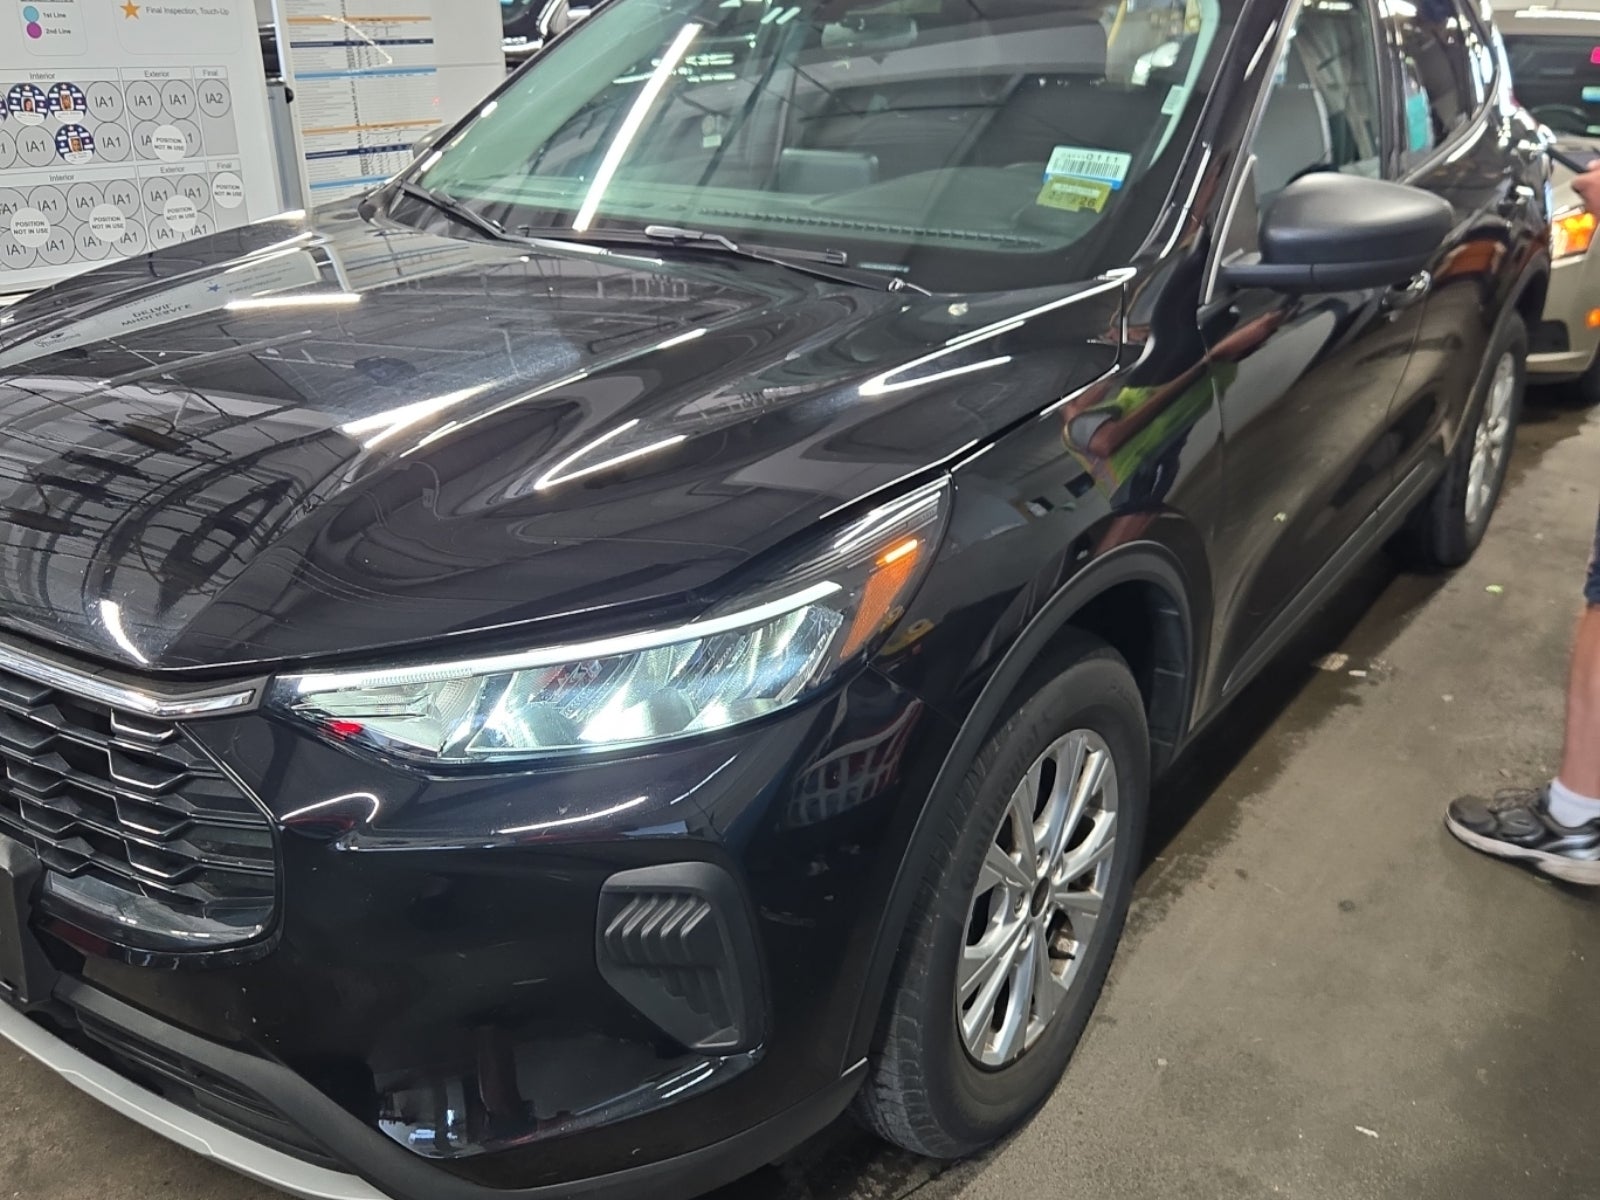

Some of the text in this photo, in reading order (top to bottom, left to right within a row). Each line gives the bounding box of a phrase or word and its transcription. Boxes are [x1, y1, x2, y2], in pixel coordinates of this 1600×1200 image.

[54, 11, 66, 19] Line
[163, 7, 199, 16] Inspection,
[200, 8, 230, 16] Touch-Up
[94, 95, 114, 108] IA1
[134, 95, 153, 107] IA1
[169, 94, 187, 105] IA1
[205, 93, 223, 104] IA2
[102, 136, 121, 149] IA1
[141, 134, 152, 146] IA
[25, 140, 46, 153] IA1
[112, 192, 131, 205] IA1
[151, 190, 168, 202] IA1
[184, 187, 201, 199] IA1
[37, 200, 57, 212] IA1
[75, 196, 95, 208] IA1
[157, 228, 174, 240] IA1
[191, 224, 207, 236] IA1
[6, 244, 27, 256] IA1
[45, 239, 65, 252] IA1
